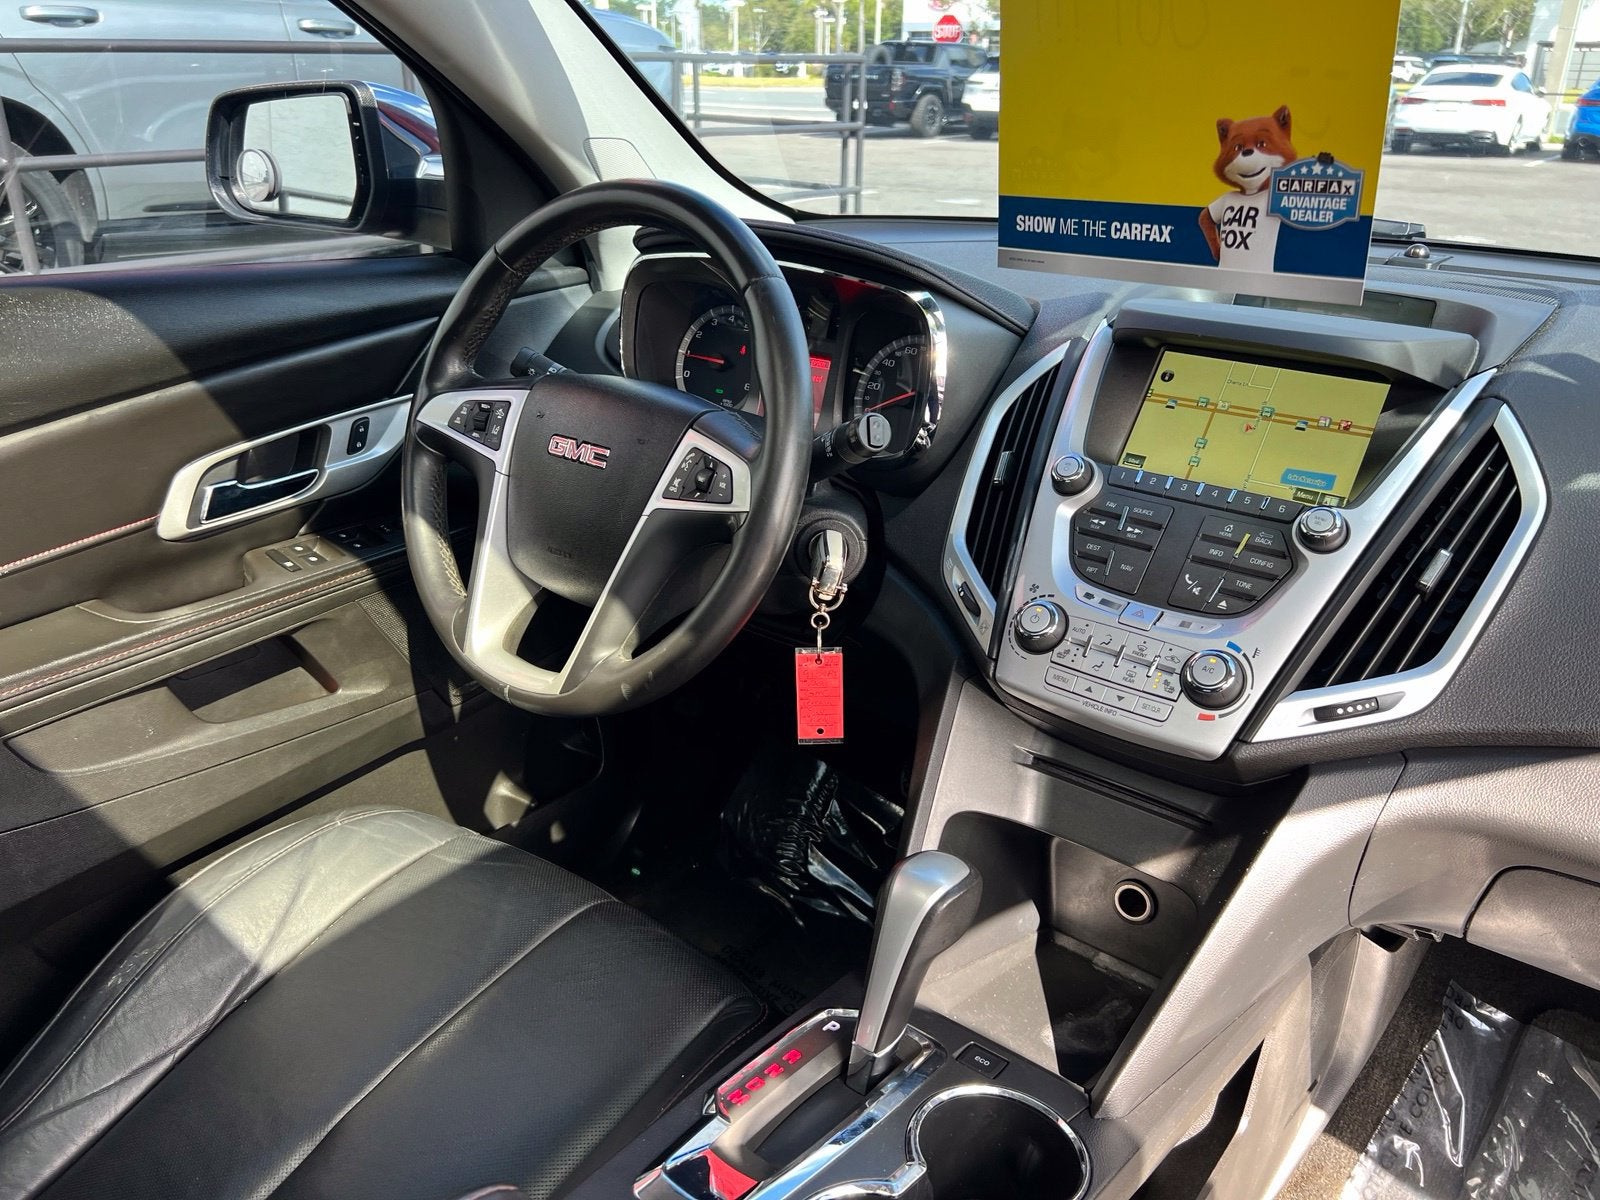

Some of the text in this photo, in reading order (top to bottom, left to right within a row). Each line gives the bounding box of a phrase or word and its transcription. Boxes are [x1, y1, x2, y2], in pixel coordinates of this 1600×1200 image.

[1278, 179, 1354, 195] CARFAX
[1280, 196, 1347, 211] ADVANTAGE
[1222, 205, 1259, 229] CAR
[1290, 209, 1333, 223] DEALER
[1016, 214, 1172, 243] SHOW ME THE CARFAX
[549, 434, 611, 469] GMC
[1086, 543, 1101, 551] DEST
[1254, 536, 1273, 546] BACK
[1208, 548, 1224, 557] INFO
[1249, 557, 1274, 569] CONFIG
[1235, 579, 1253, 590] TONE
[1082, 700, 1118, 717] VEHICLE INFO
[822, 1020, 840, 1031] P
[974, 1055, 990, 1066] eco
